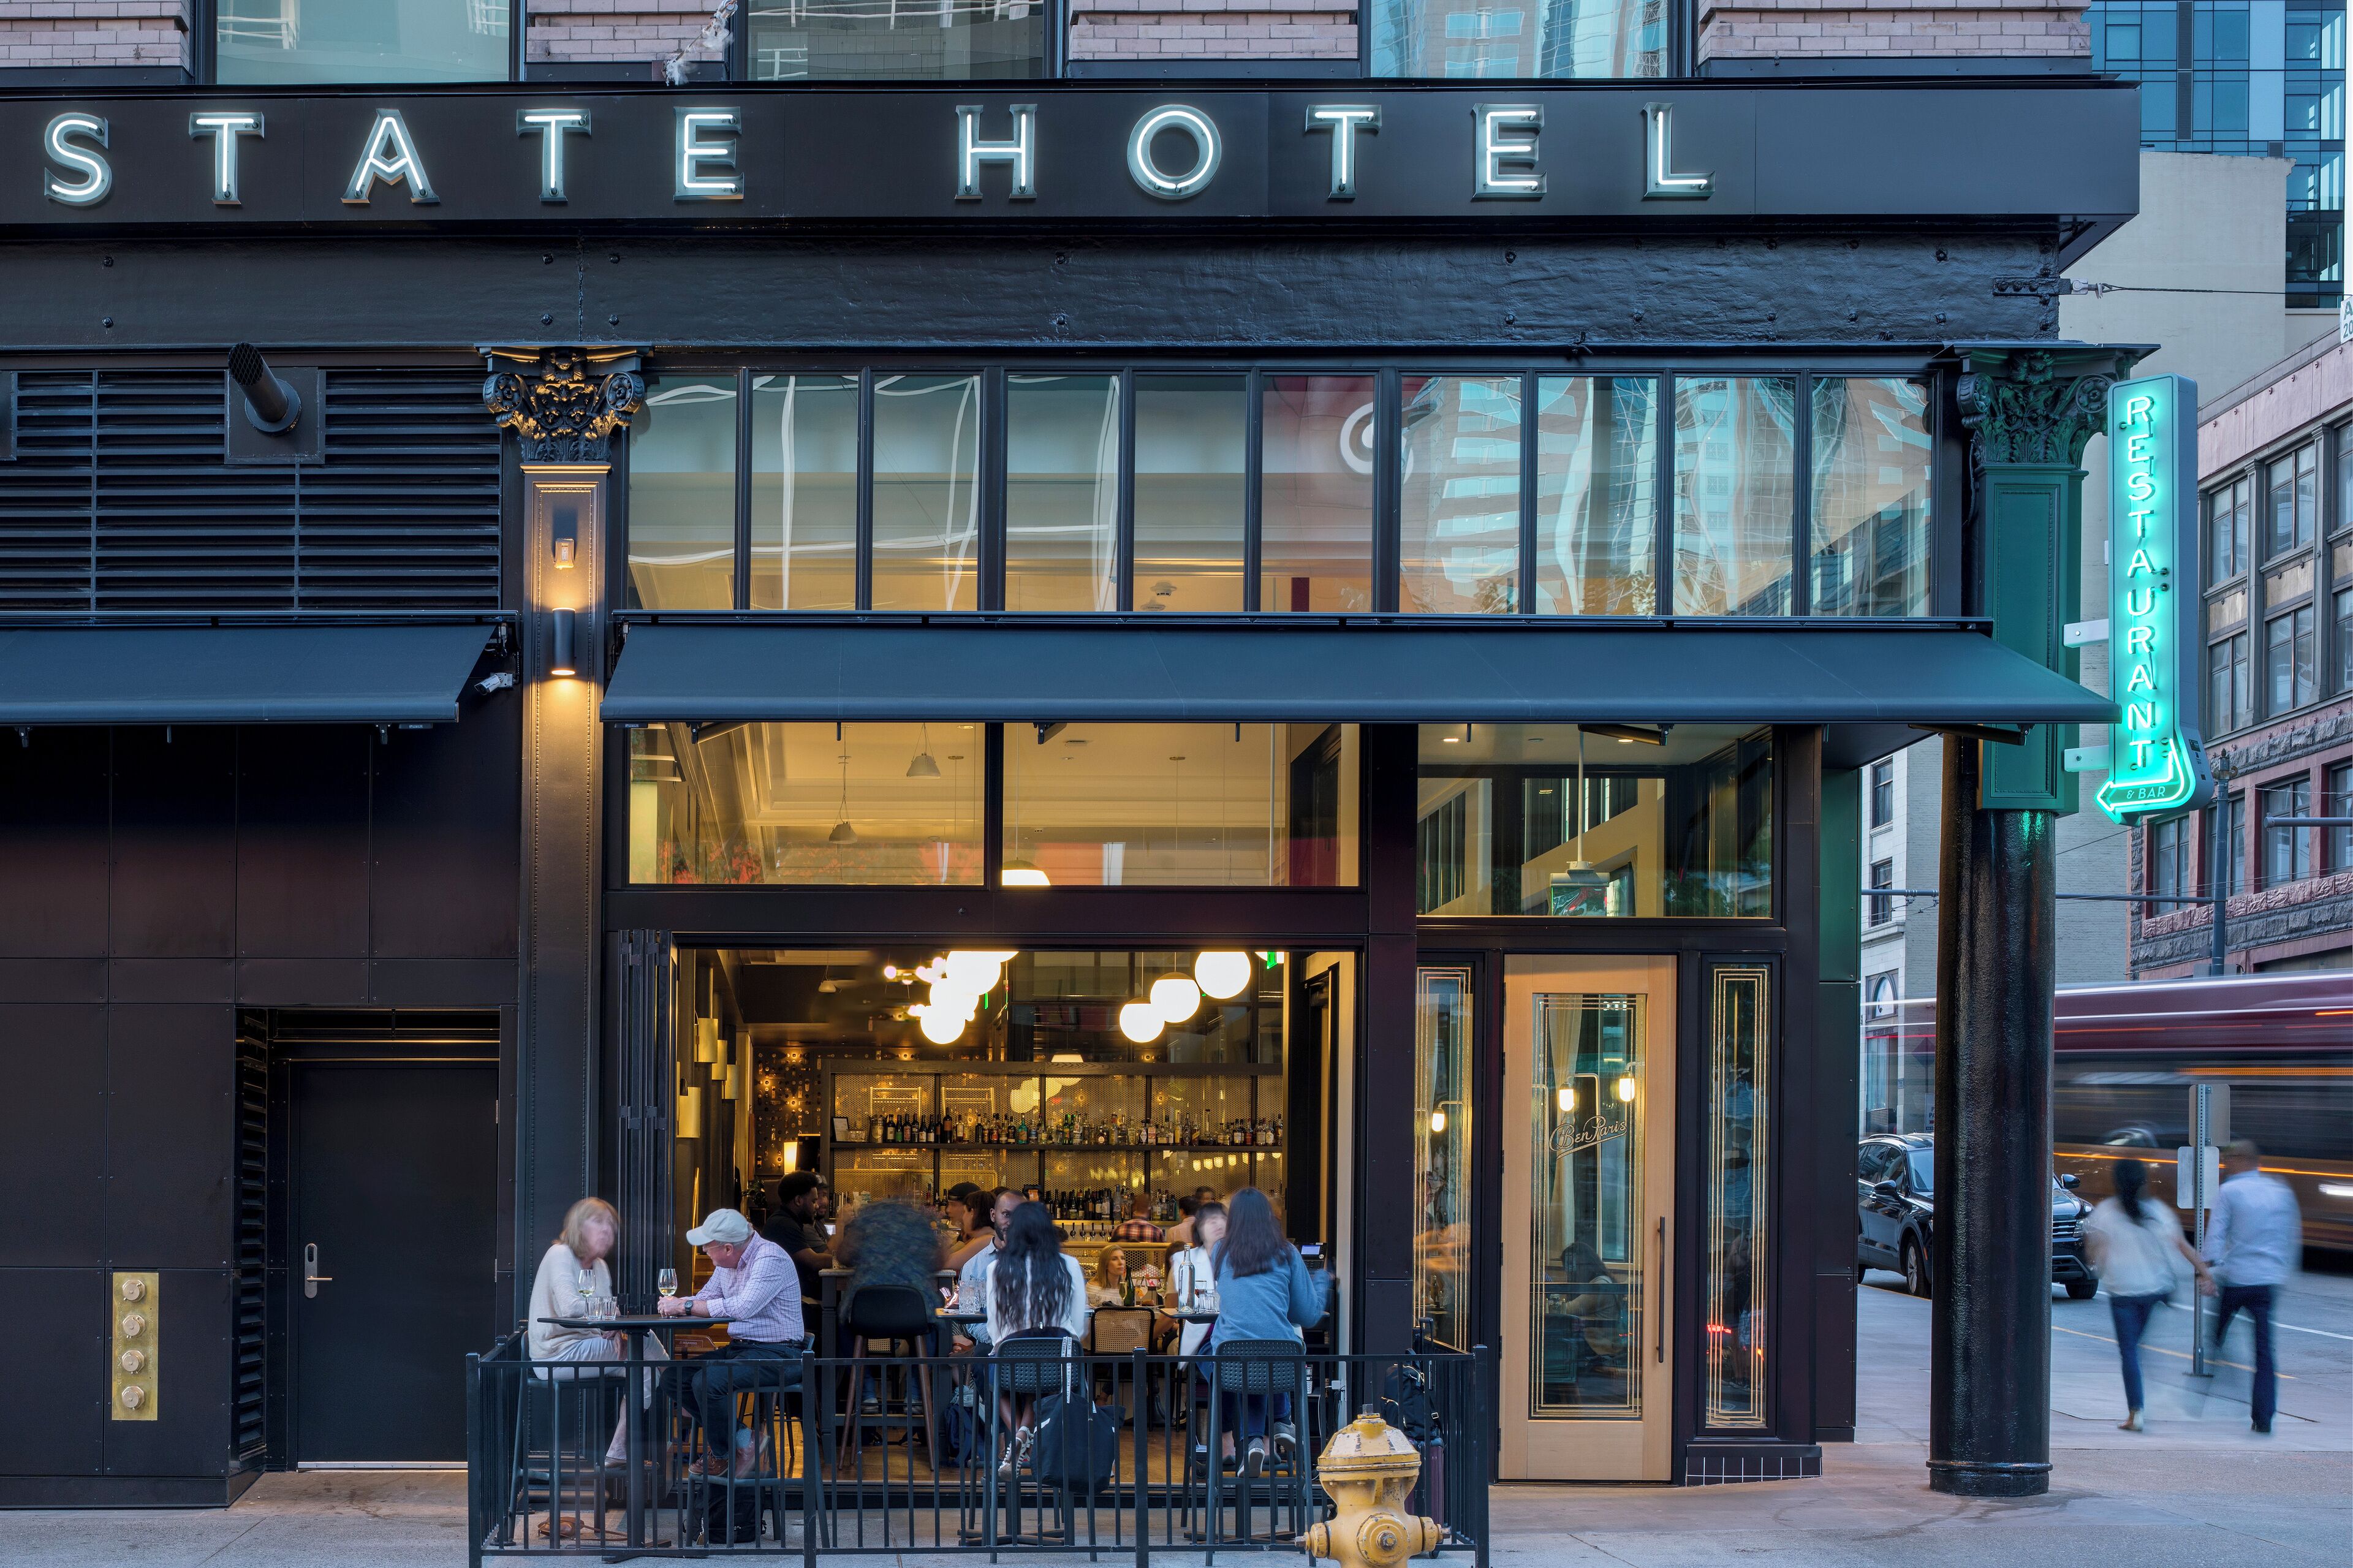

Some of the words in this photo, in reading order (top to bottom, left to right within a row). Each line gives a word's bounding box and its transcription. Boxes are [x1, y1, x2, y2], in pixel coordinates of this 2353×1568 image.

[44, 105, 745, 206] STATE
[954, 102, 1715, 200] HOTEL
[2127, 395, 2156, 768] RESTAURANT
[2126, 790, 2135, 800] &
[2138, 786, 2166, 800] BAR
[1548, 1123, 1590, 1152] Ben
[1583, 1115, 1627, 1143] Paris
